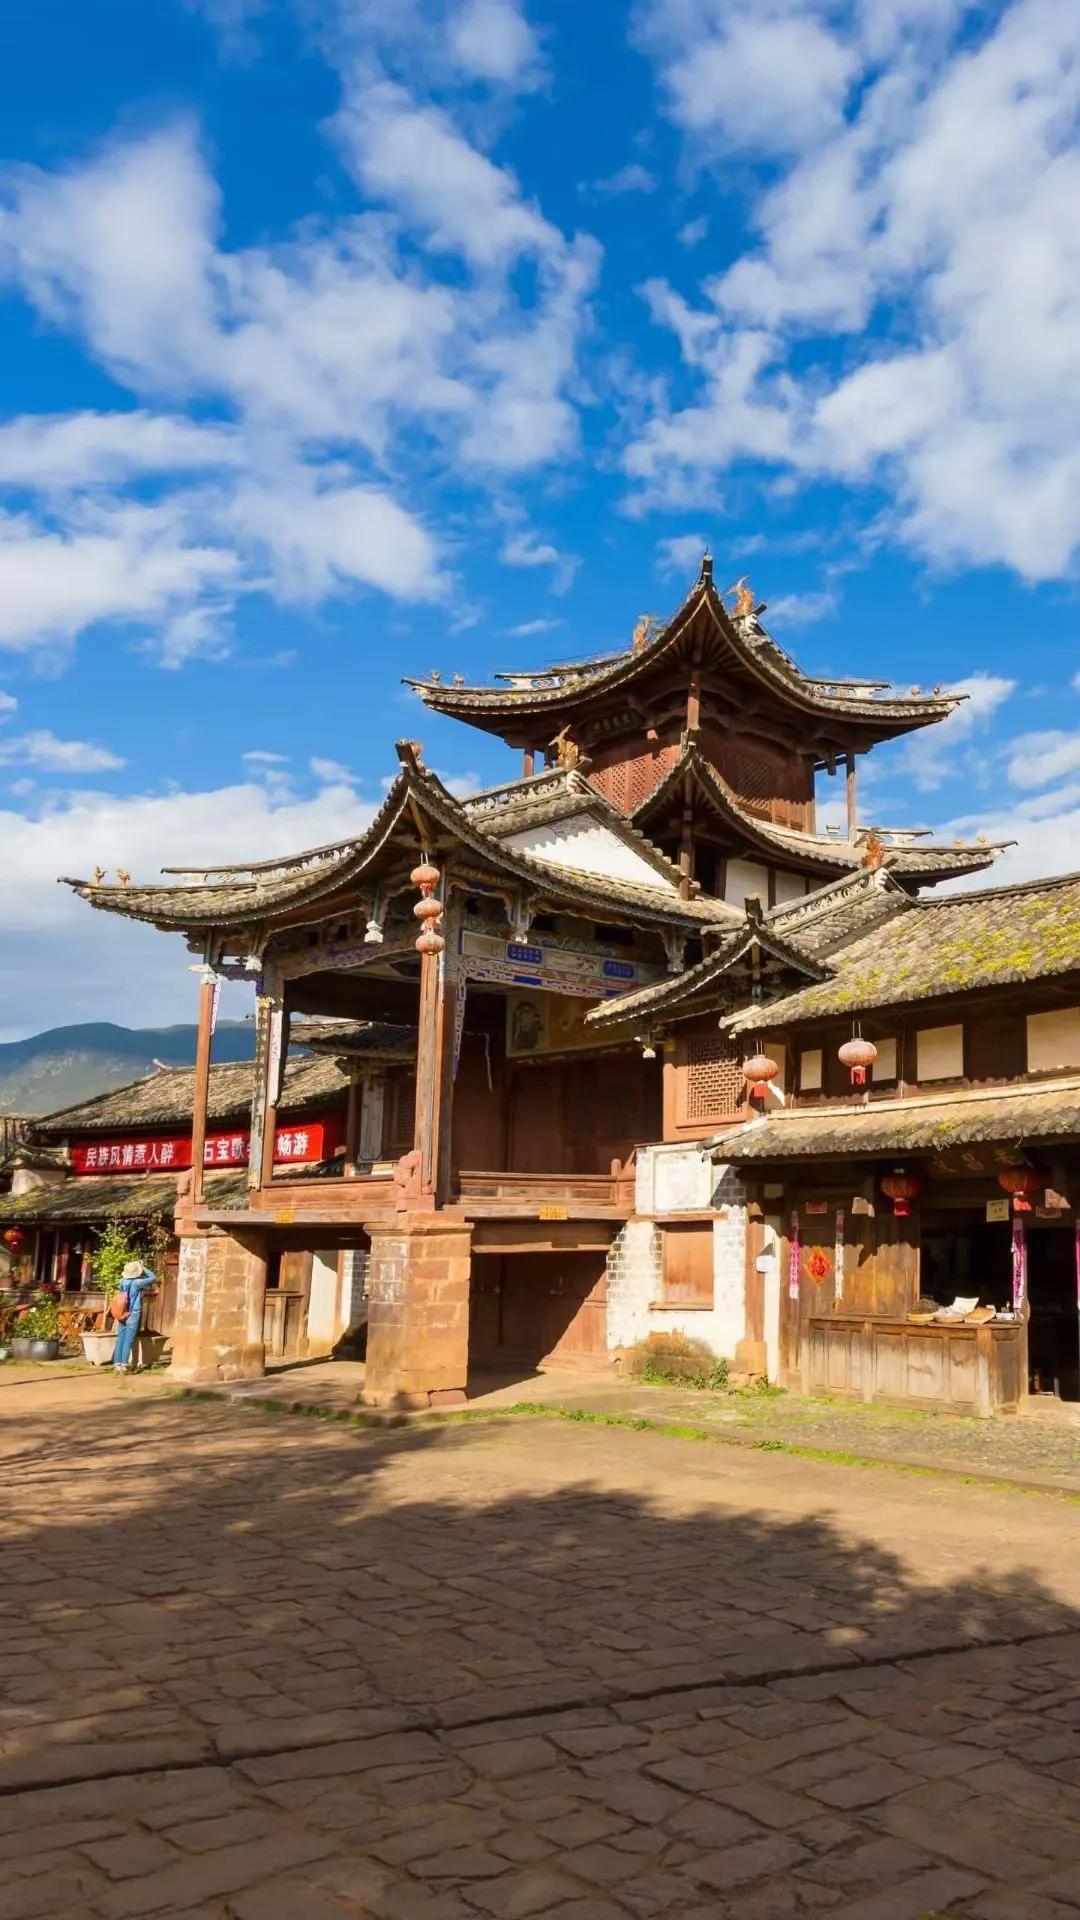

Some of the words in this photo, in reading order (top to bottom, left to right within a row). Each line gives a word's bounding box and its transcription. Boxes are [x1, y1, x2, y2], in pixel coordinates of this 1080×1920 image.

[85, 1142, 174, 1167] 民族风情惹人醉
